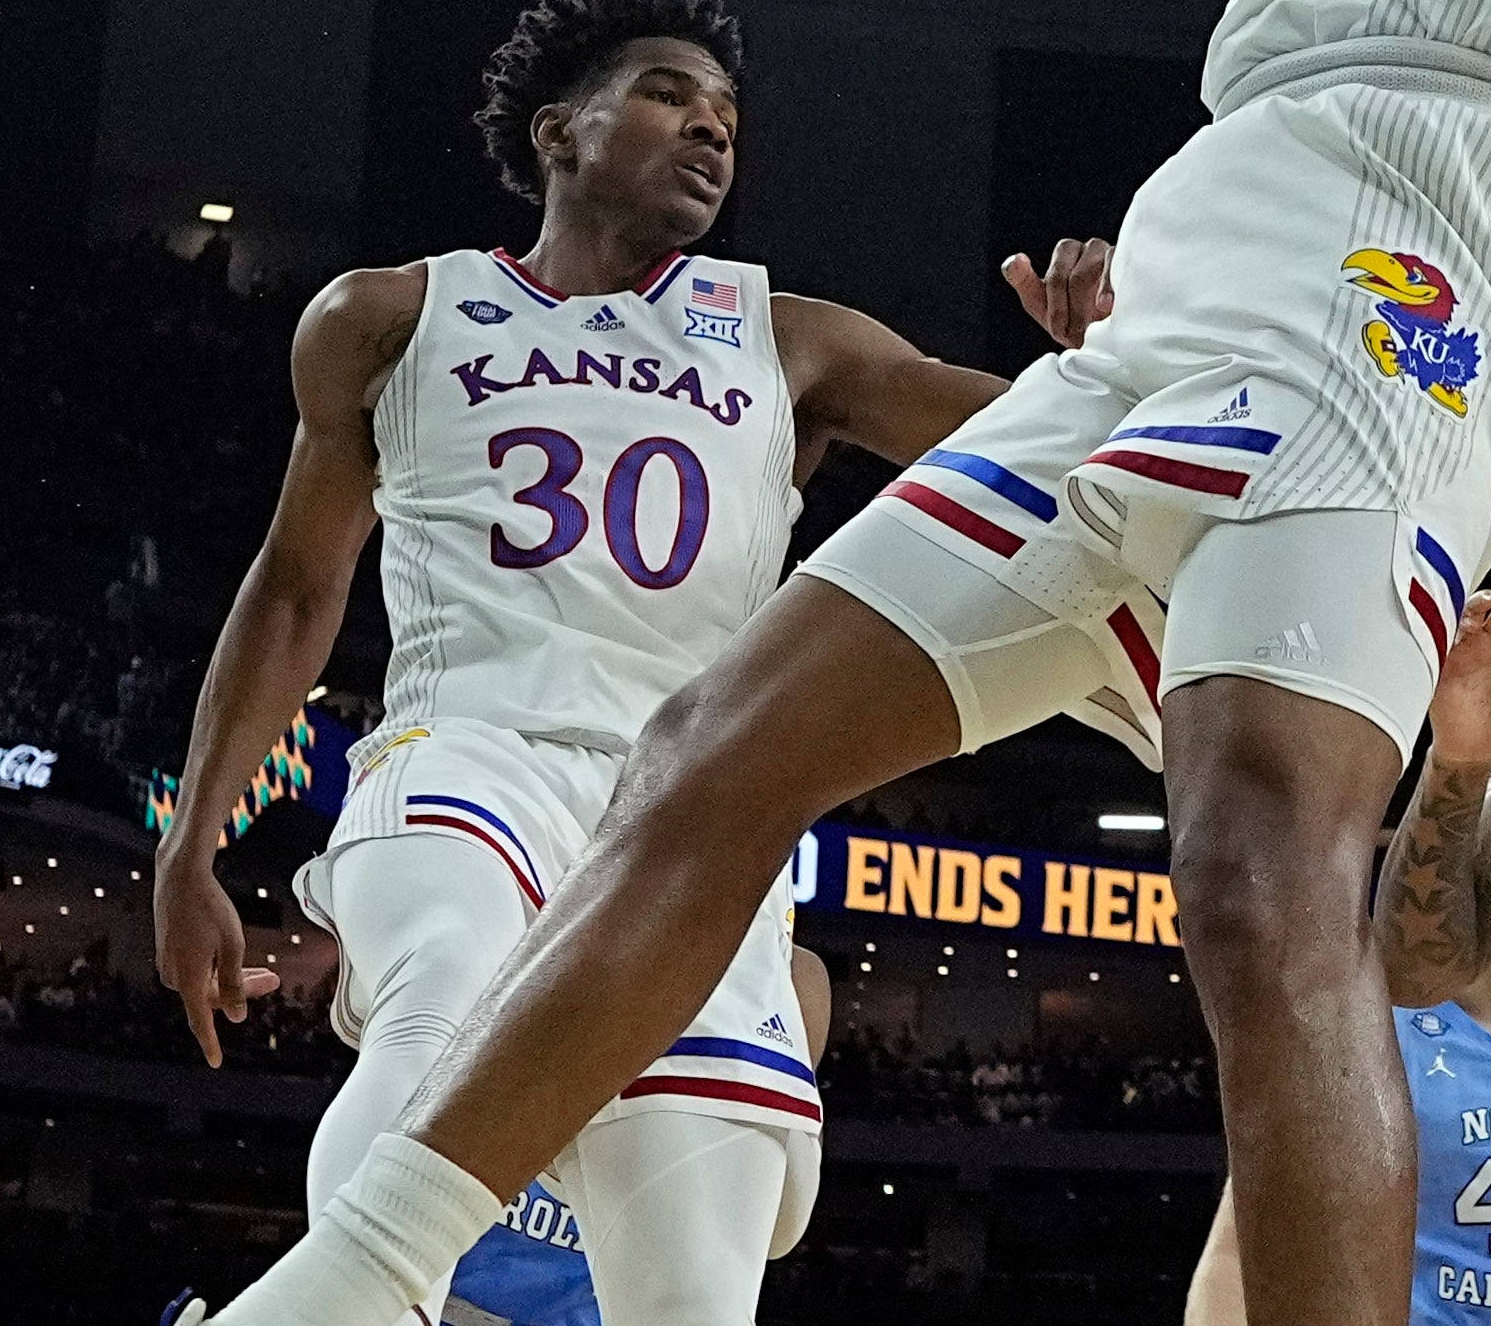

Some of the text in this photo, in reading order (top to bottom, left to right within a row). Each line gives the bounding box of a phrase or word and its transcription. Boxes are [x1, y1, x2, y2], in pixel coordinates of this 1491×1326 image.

[580, 320, 625, 332] adidas
[1409, 326, 1450, 365] KU
[449, 346, 754, 427] KANSAS
[487, 426, 711, 591] 30
[843, 835, 1023, 929] ENDS
[754, 1023, 795, 1049] adidas
